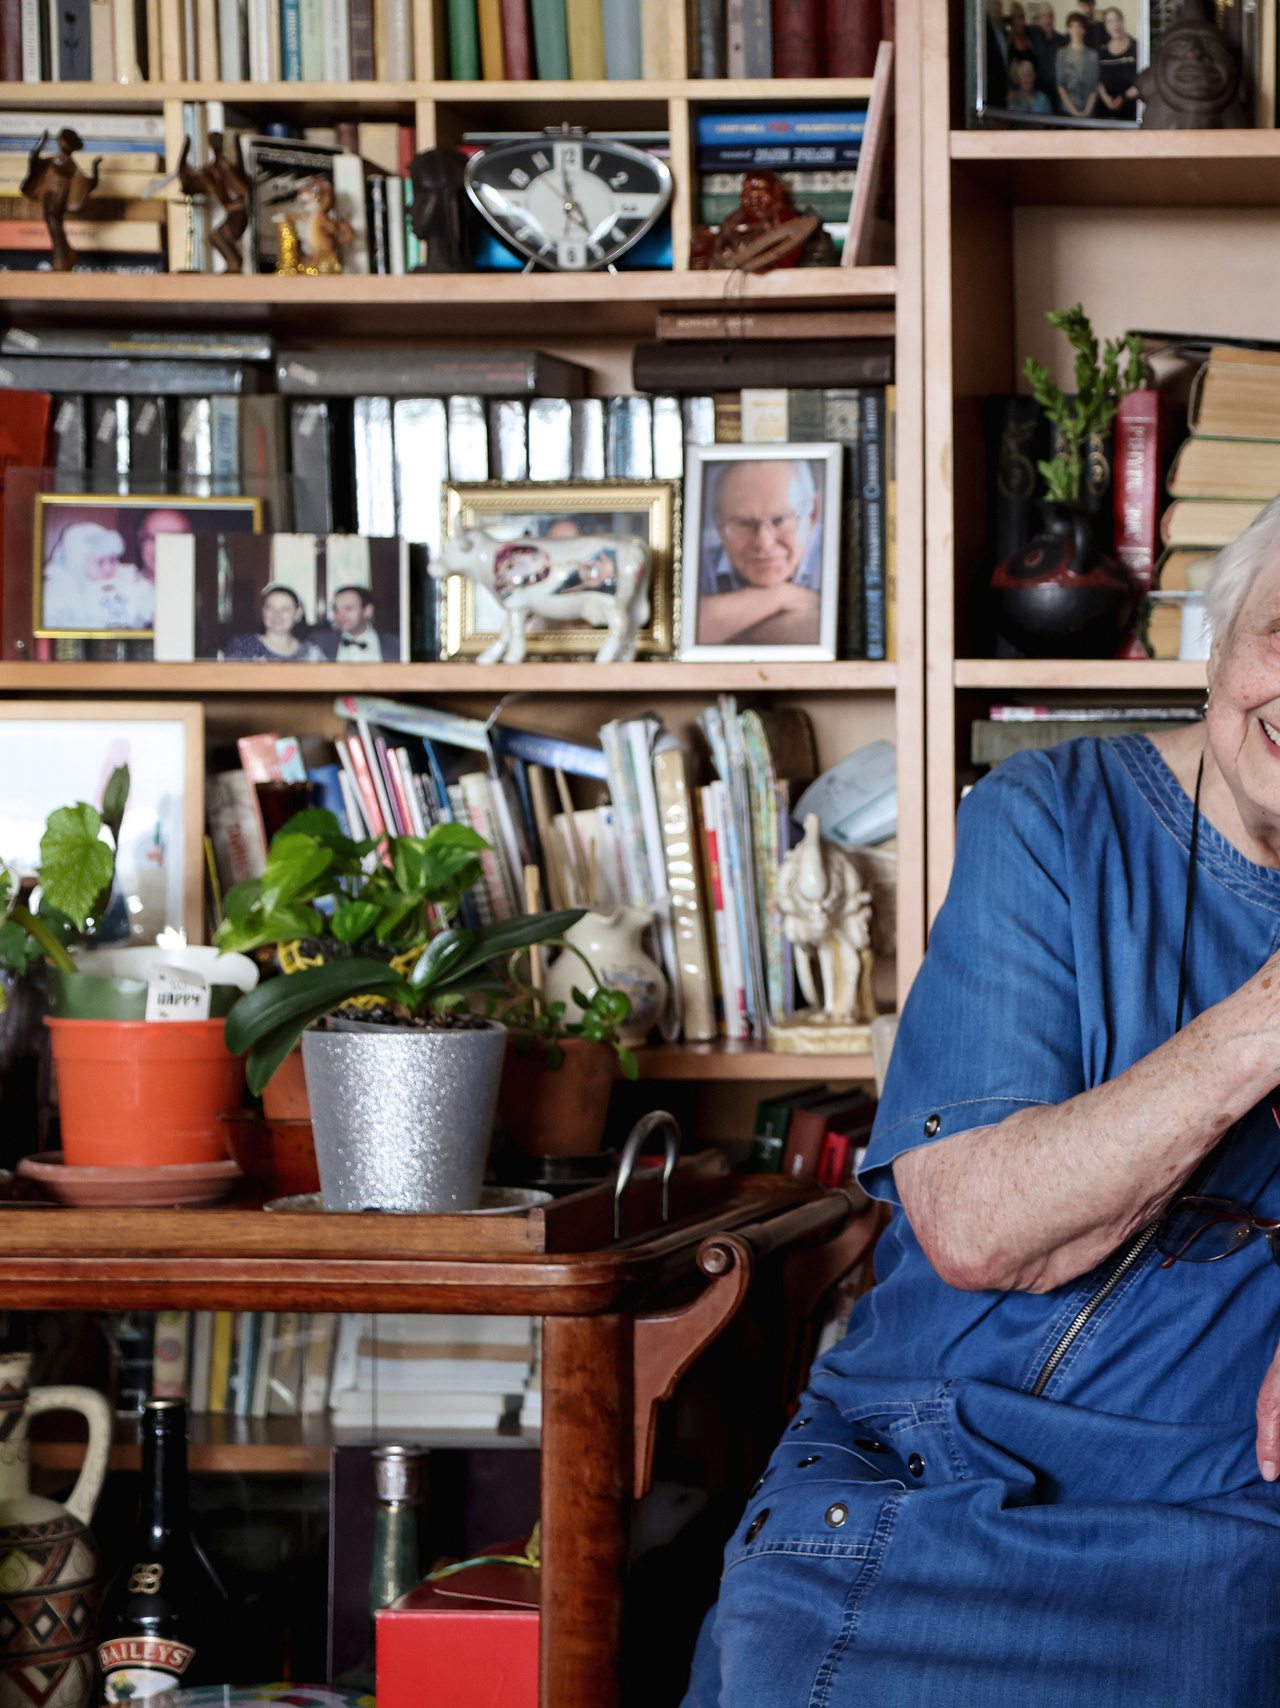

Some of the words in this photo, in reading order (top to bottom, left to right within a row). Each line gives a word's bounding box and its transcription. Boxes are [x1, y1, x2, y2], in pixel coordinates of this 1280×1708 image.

[563, 147, 576, 163] 12
[609, 171, 630, 190] 2
[566, 248, 577, 263] 6
[158, 992, 201, 1006] HAPPY
[100, 1642, 188, 1666] BAILEYS
